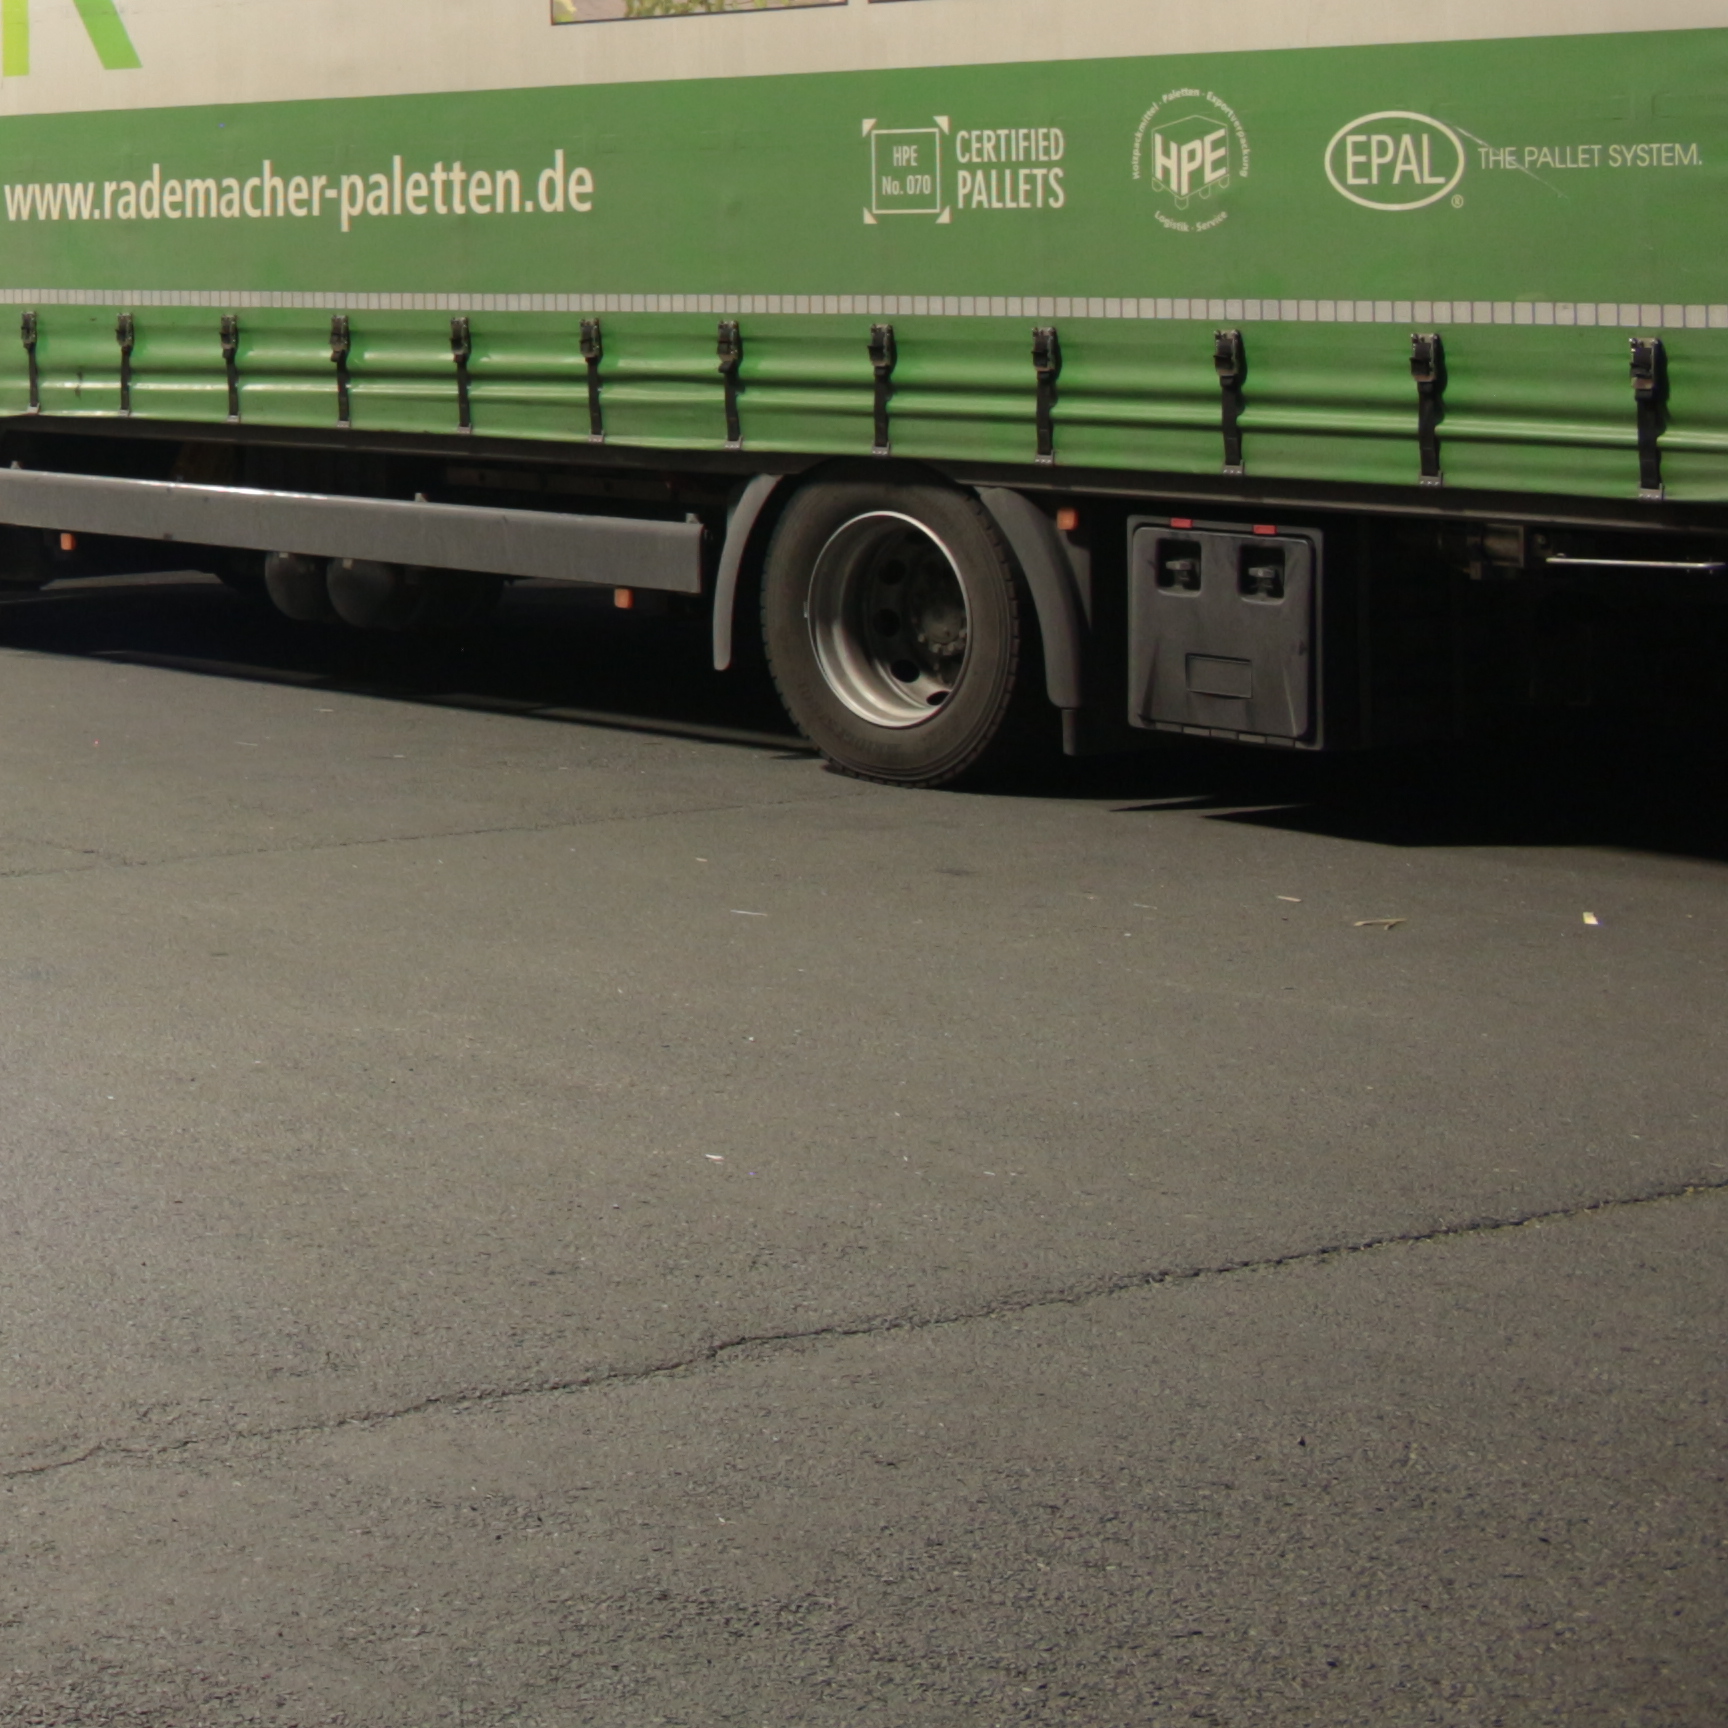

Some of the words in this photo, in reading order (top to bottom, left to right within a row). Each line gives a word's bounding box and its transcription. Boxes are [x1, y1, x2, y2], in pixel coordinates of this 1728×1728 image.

[893, 145, 918, 166] HPE
[955, 127, 1065, 164] CERTIFIED
[1154, 127, 1227, 197] HPE
[1345, 133, 1446, 186] EPAL
[1477, 146, 1517, 170] THE
[1524, 145, 1602, 169] PALLET
[1608, 143, 1703, 168] SYSTEM.
[4, 148, 594, 233] www.rademacher-paletten.de
[882, 176, 904, 195] No.
[906, 175, 931, 195] 070
[957, 167, 1066, 209] PALLETS
[1154, 210, 1190, 233] Logistik
[1195, 210, 1228, 233] Service
